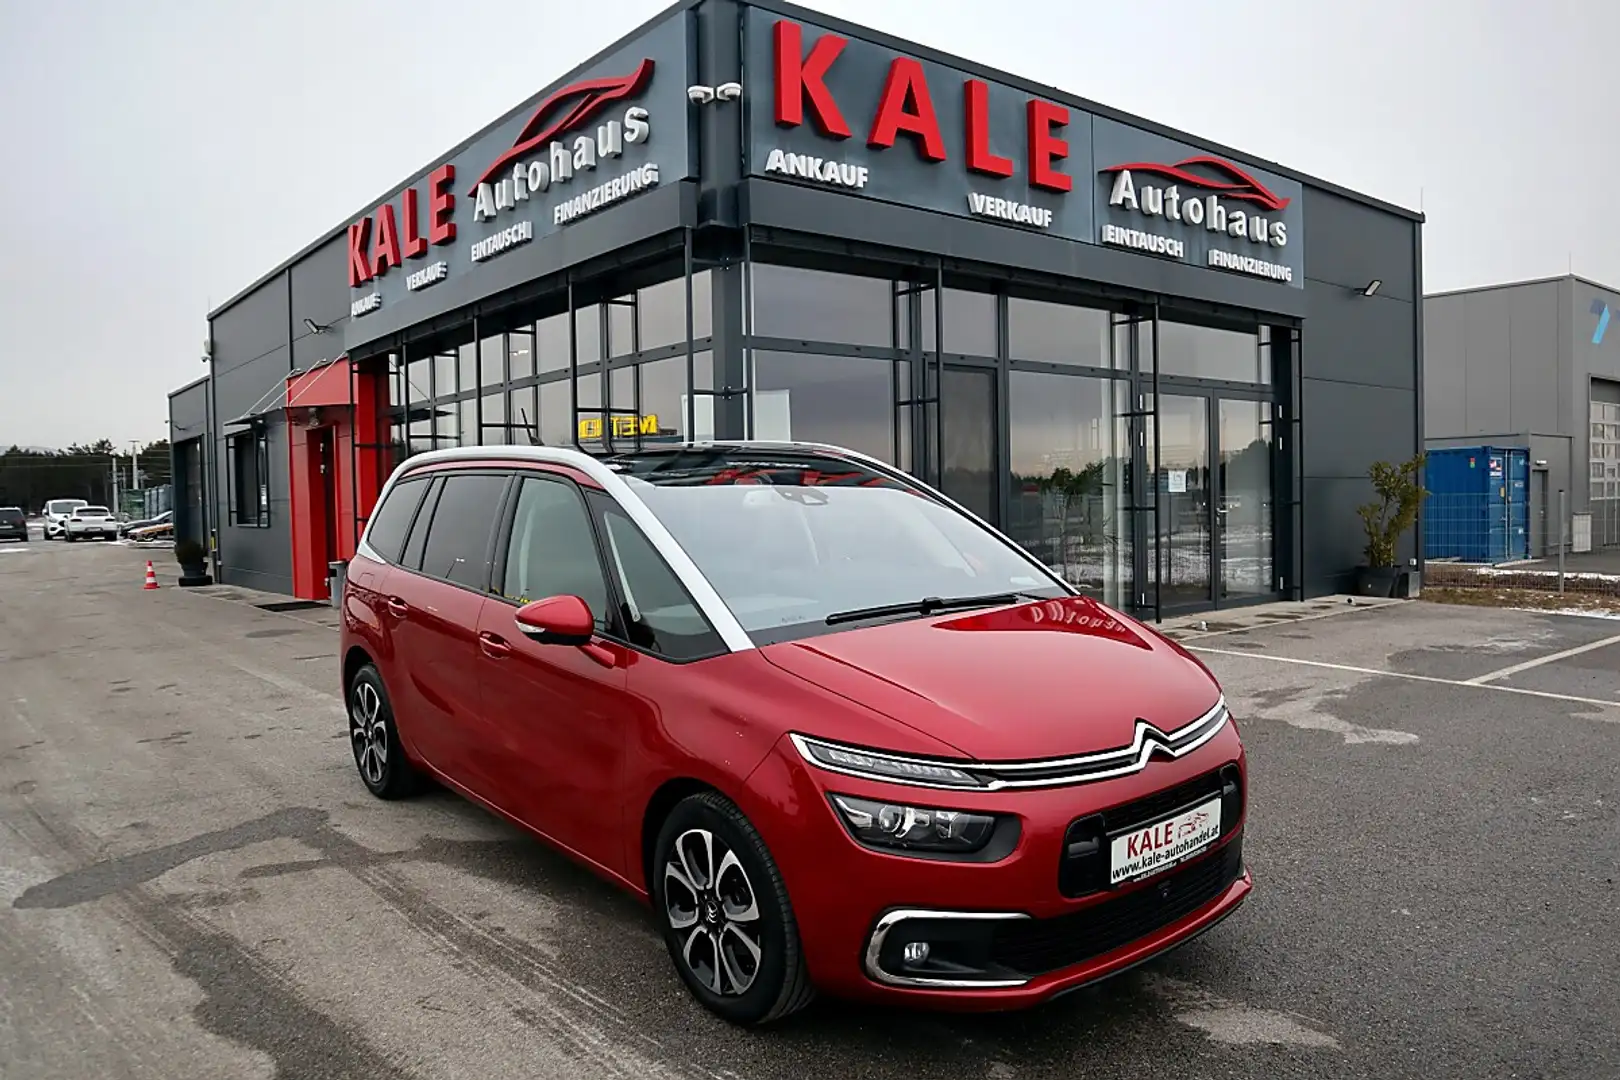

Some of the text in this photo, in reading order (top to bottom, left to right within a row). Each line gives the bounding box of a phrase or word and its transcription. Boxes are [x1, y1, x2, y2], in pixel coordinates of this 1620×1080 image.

[773, 20, 1072, 191] KALE
[474, 106, 649, 221] Autohaus
[765, 149, 868, 188] ANKAUF
[554, 164, 659, 223] FINANZIERUNG
[967, 192, 1052, 228] VERKAUF
[1109, 169, 1288, 247] Autohaus
[347, 165, 456, 286] KALE
[471, 221, 532, 261] EINTAUSCH
[1101, 225, 1184, 258] EINTAUSCH
[1208, 249, 1292, 282] FINANZIERUNG
[1112, 825, 1219, 879] www.kale-autohandel.at
[1127, 822, 1174, 859] KALE
